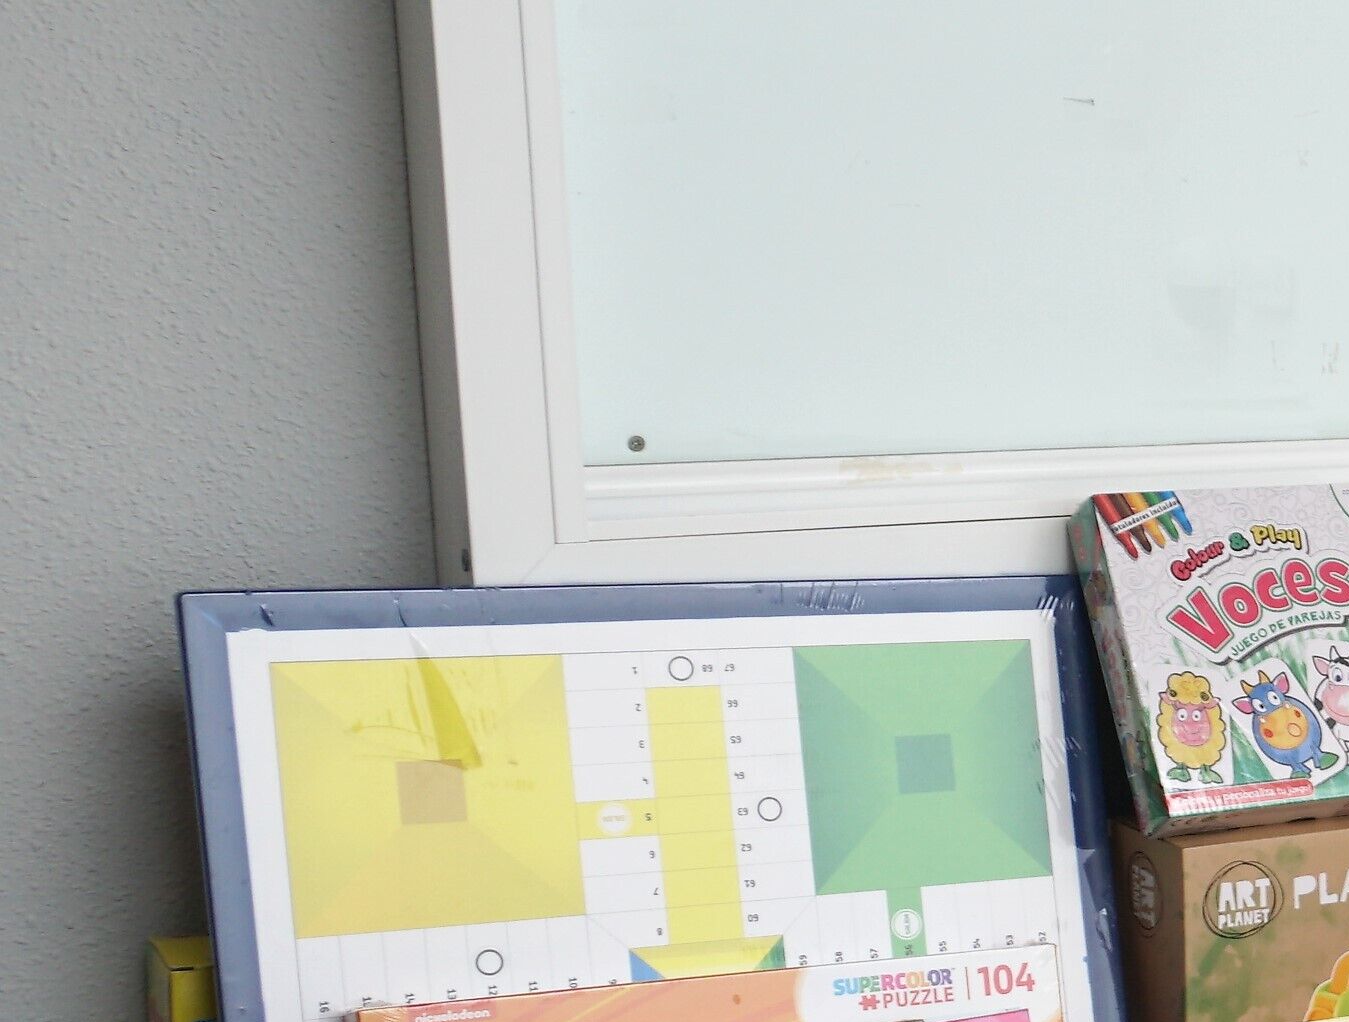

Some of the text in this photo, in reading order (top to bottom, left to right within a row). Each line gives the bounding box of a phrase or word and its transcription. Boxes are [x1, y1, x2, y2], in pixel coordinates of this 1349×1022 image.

[1170, 524, 1303, 581] Colour & Play
[1231, 609, 1343, 656] JUEGO DE PAREJAS
[1216, 876, 1272, 909] ART
[1217, 906, 1272, 928] PLANET
[833, 968, 954, 997] SUPERCOLOR
[976, 962, 1037, 997] 104
[318, 1000, 330, 1014] 16
[882, 986, 956, 1010] PUZZLE
